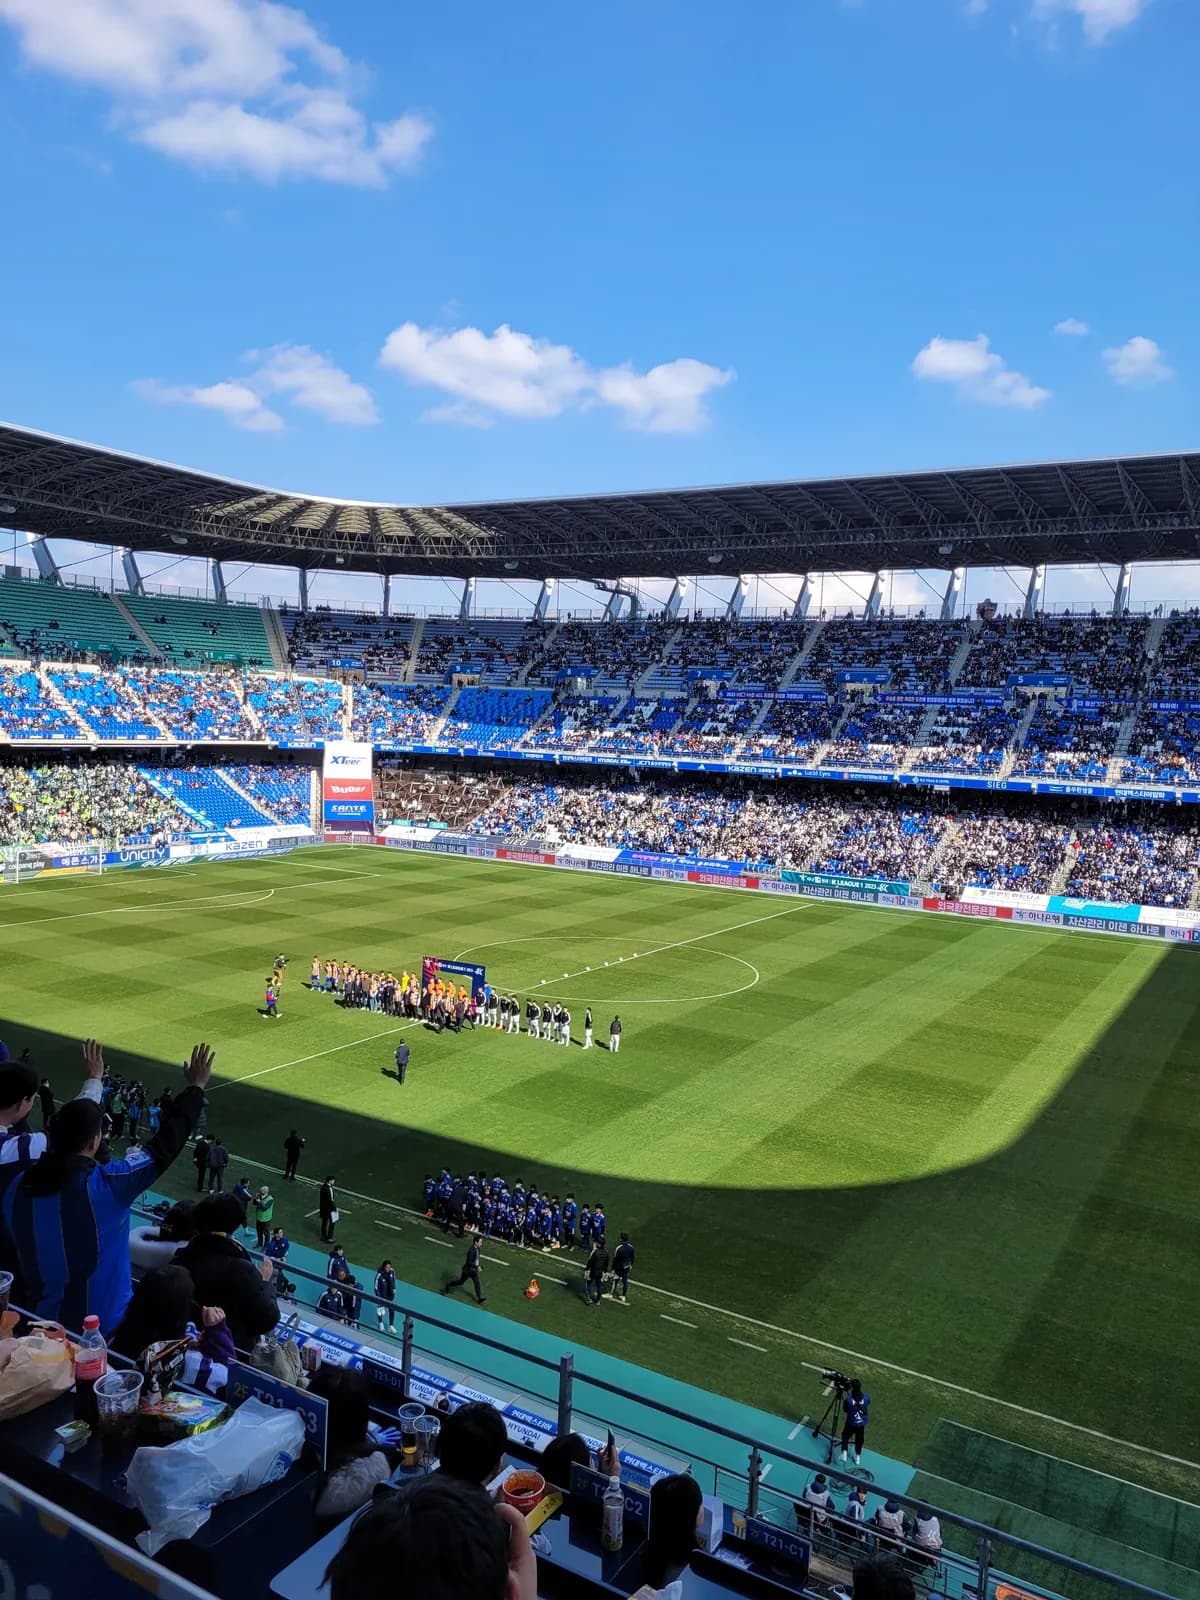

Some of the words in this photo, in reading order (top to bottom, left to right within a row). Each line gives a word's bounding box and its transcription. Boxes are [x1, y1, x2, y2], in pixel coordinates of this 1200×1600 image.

[986, 781, 1007, 789] SIEG
[502, 837, 529, 846] SIEG
[120, 848, 165, 862] UNICITY
[1068, 915, 1106, 930] 자산관리
[1108, 920, 1128, 932] 이젠
[507, 1422, 542, 1441] HYUNDAI
[762, 1531, 805, 1561] T21-C1
